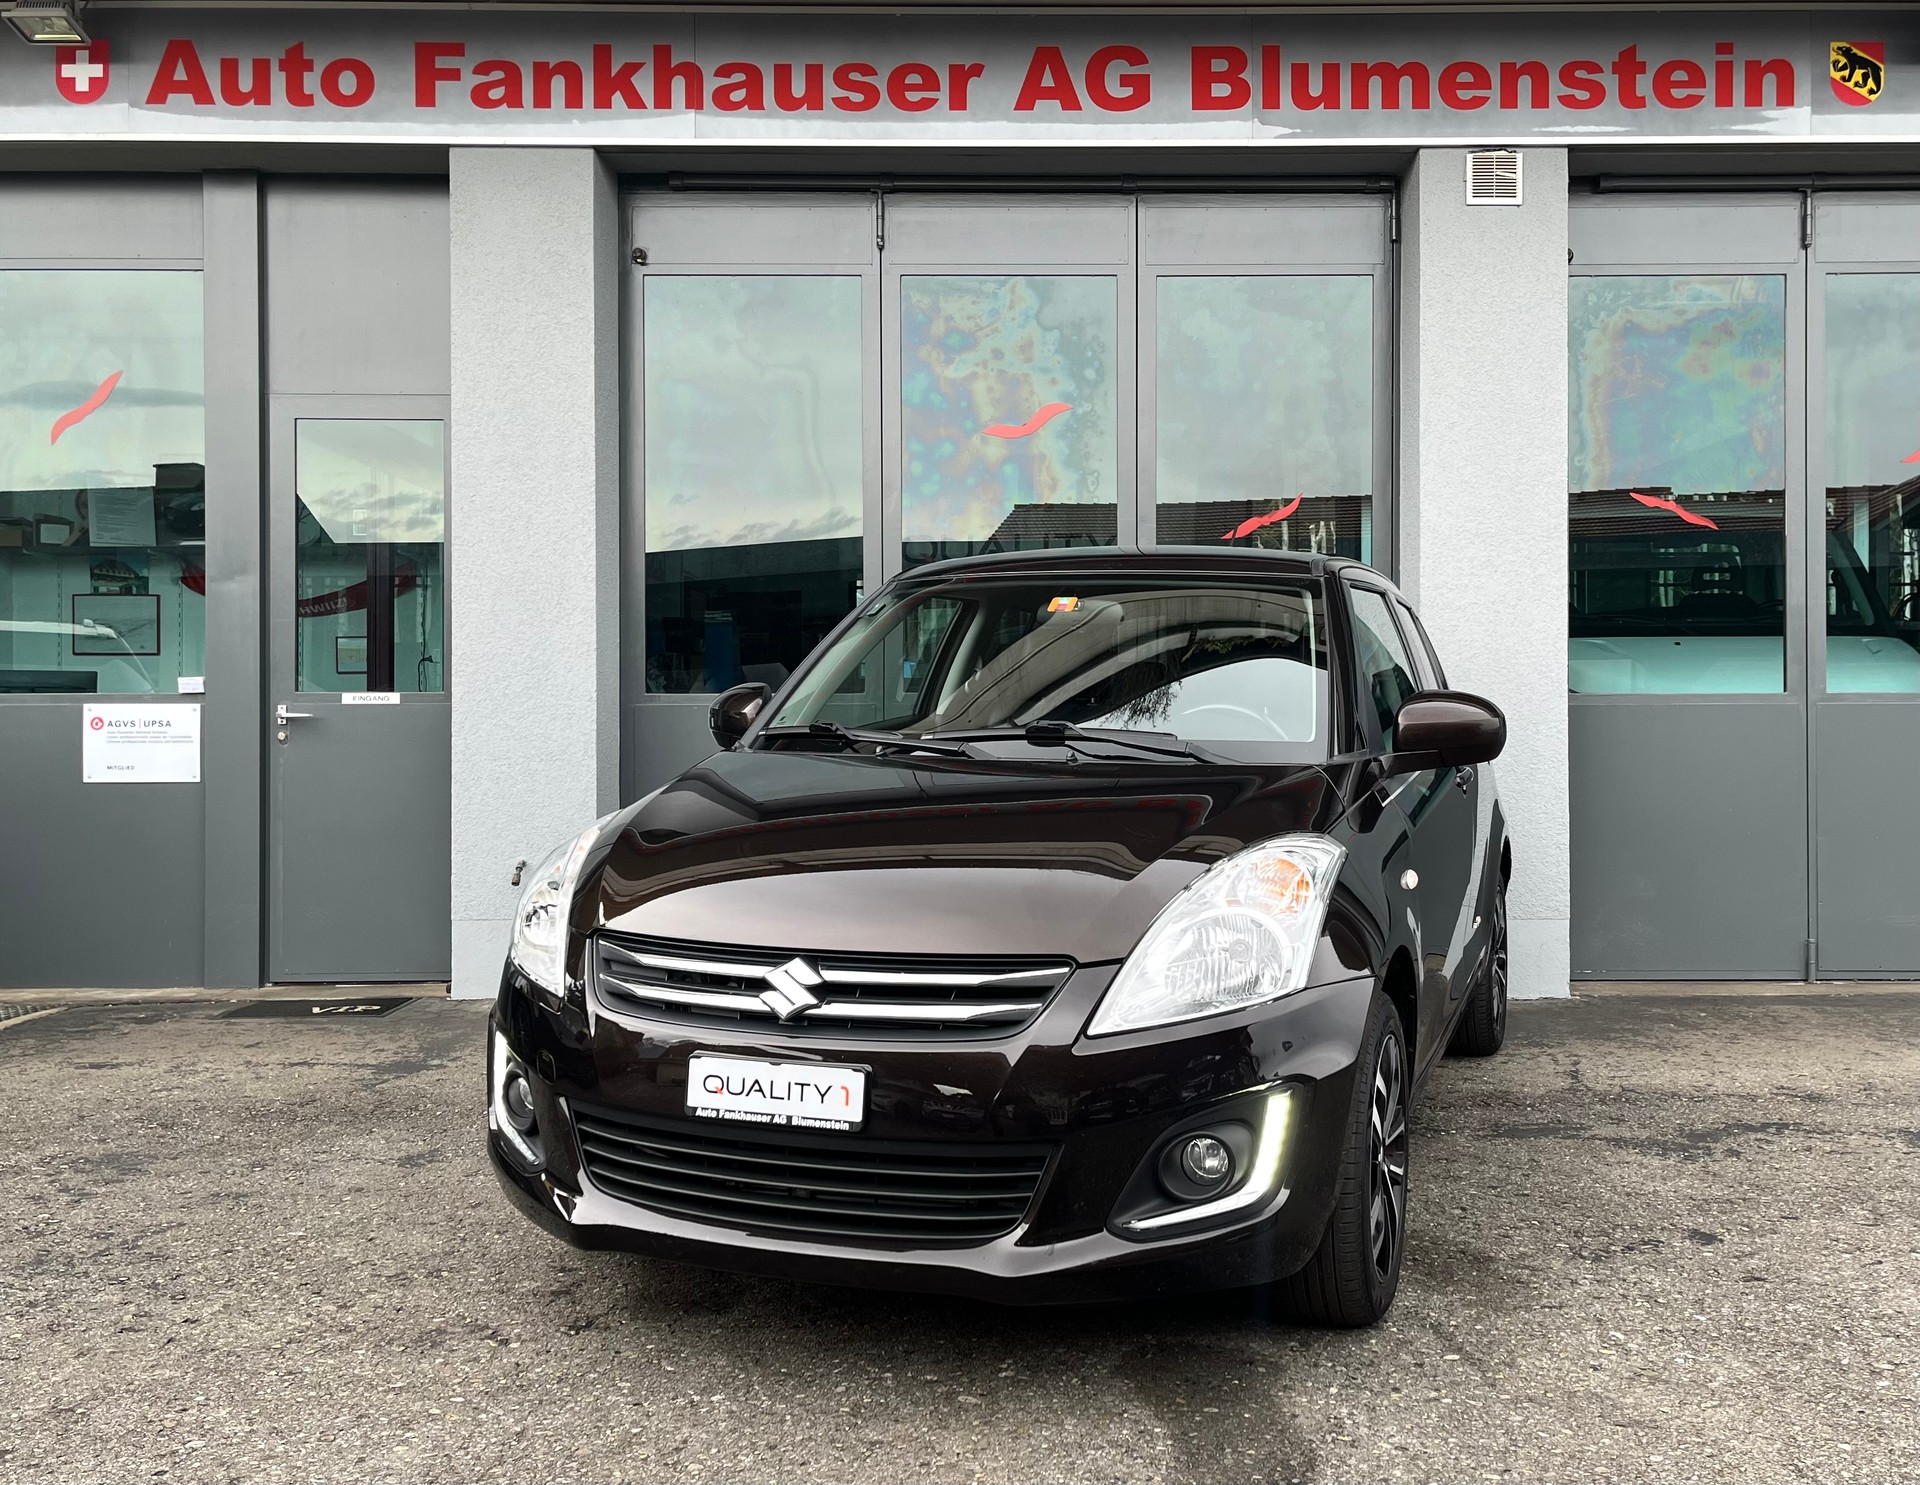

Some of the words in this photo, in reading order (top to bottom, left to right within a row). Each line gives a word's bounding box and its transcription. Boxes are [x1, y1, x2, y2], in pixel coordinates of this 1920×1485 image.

[147, 40, 375, 106] Auto
[416, 43, 984, 111] Fankhauser
[1015, 46, 1151, 112] AG
[1192, 44, 1796, 110] Blumenstein
[107, 720, 136, 728] AGVS
[143, 720, 171, 728] UPSA
[703, 1074, 832, 1104] QUALITY
[841, 1085, 849, 1107] 1
[695, 1107, 717, 1118] Auto
[718, 1109, 772, 1124] Fankhauser
[773, 1115, 787, 1125] AG
[791, 1116, 849, 1131] Blumenstein
